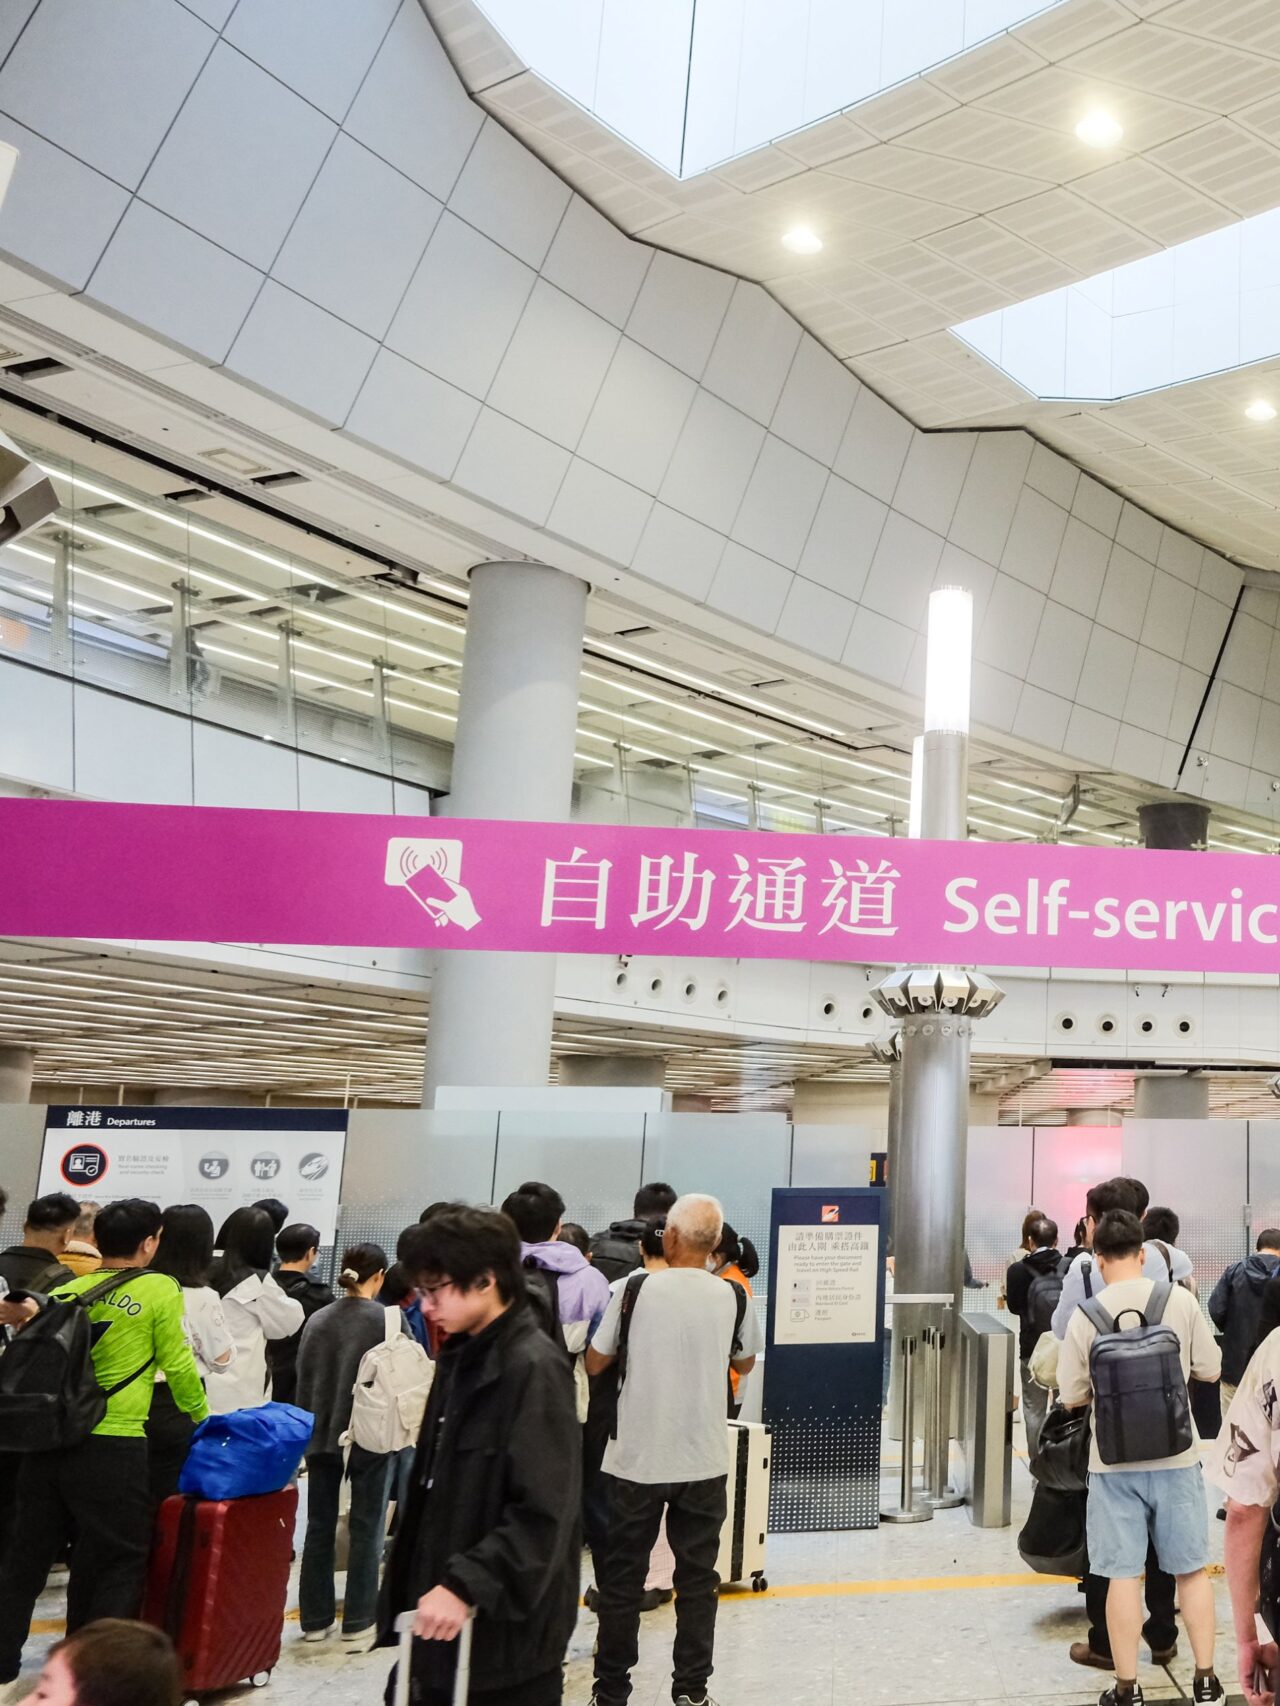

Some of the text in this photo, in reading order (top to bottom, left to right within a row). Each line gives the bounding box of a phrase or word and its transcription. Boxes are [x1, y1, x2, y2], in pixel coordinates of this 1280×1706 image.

[541, 846, 902, 937] 自助通道
[66, 1110, 102, 1127] 離港
[107, 1117, 156, 1127] Departures
